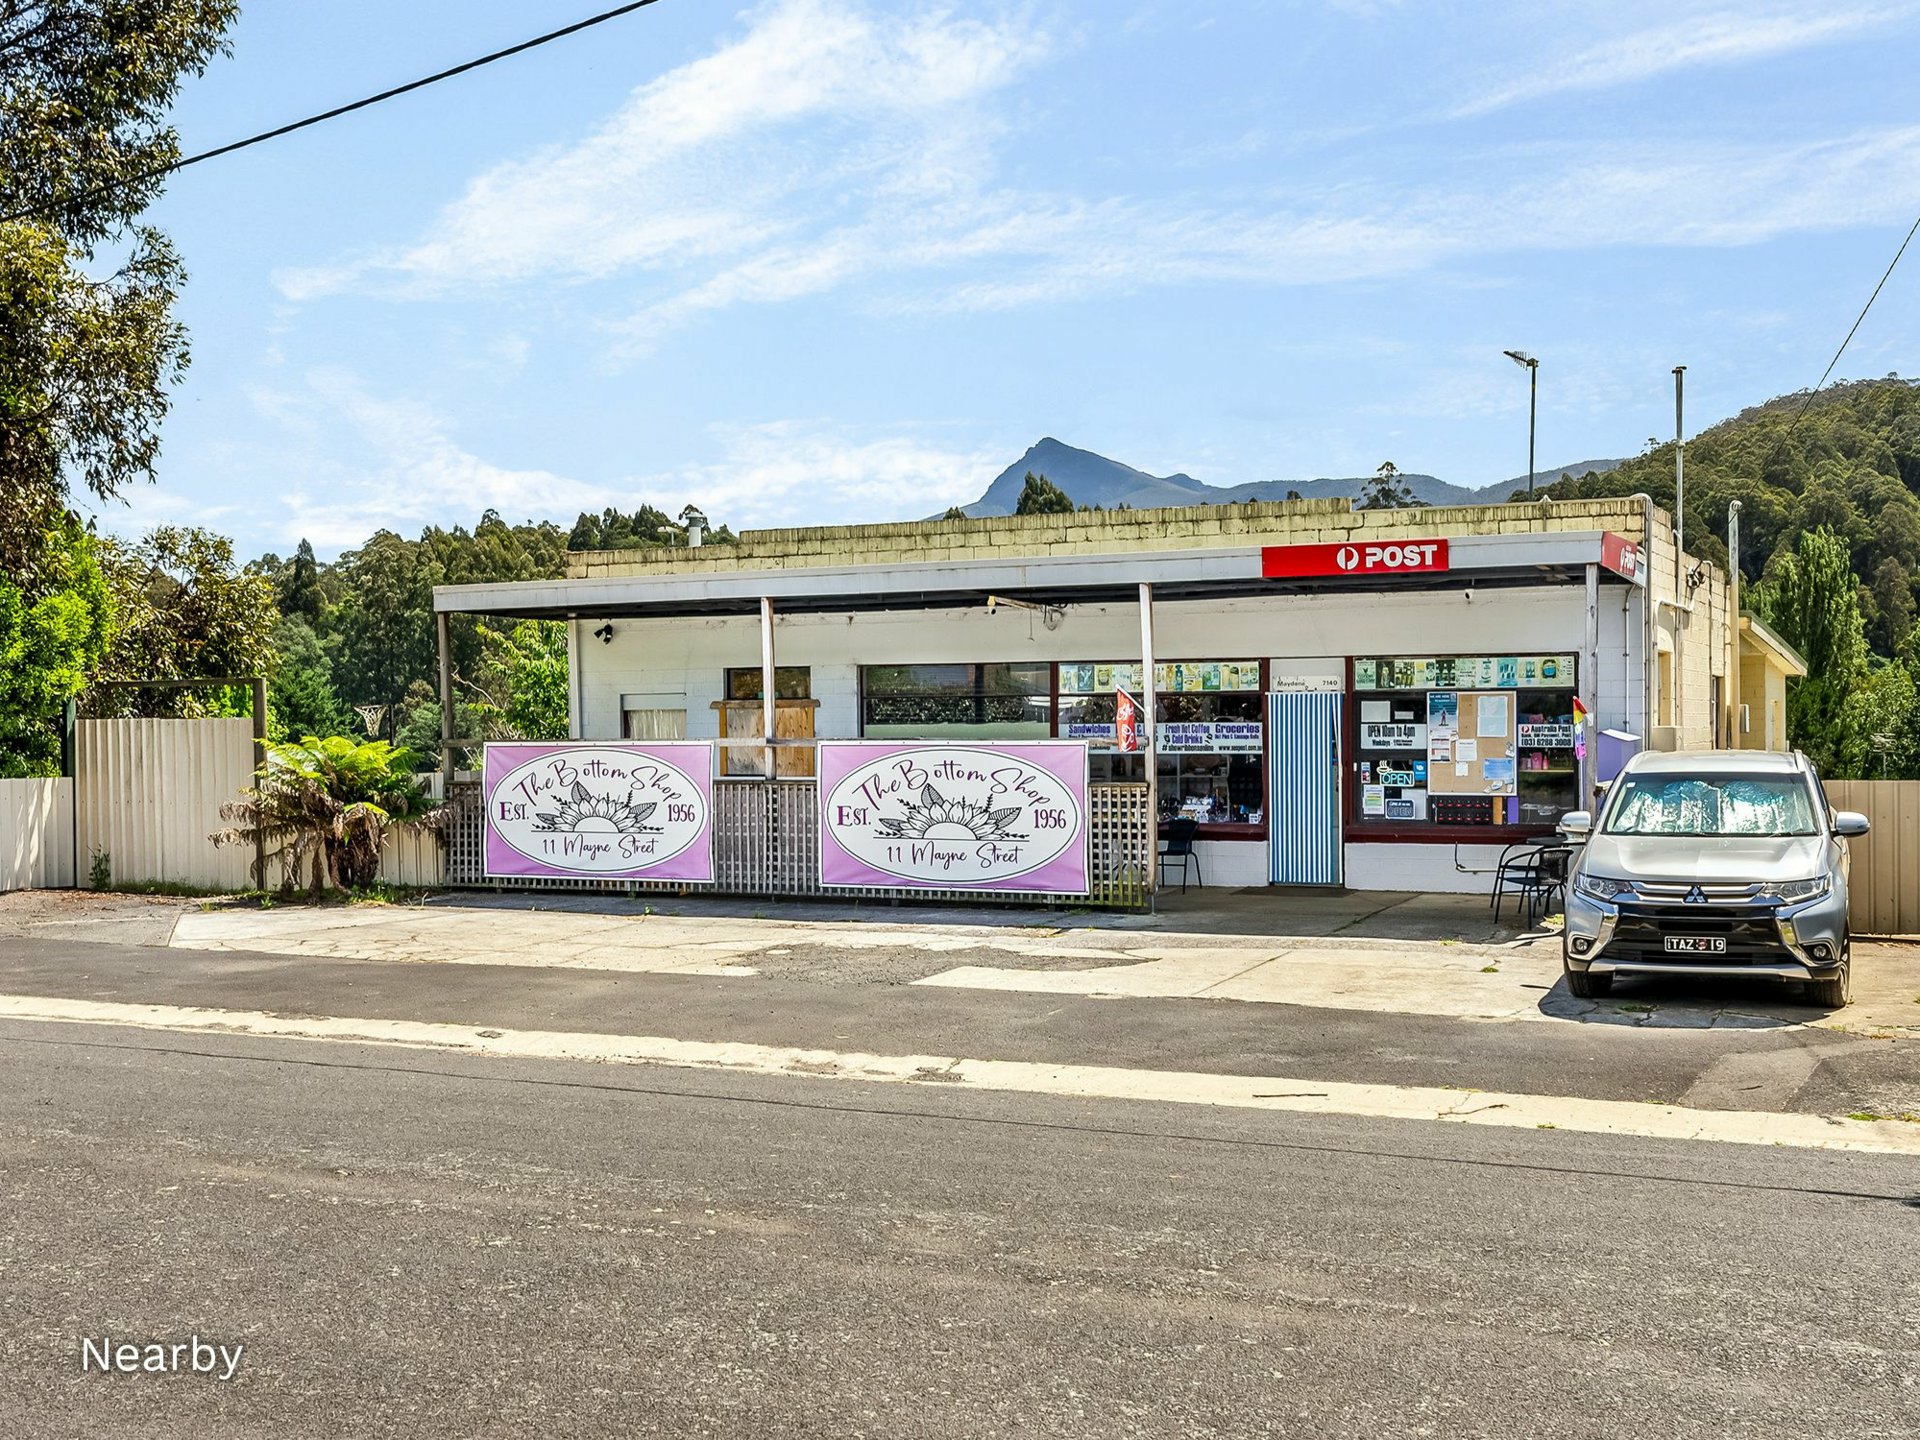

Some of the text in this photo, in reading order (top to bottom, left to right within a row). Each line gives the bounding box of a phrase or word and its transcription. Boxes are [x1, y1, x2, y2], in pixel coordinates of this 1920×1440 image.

[1365, 544, 1438, 568] POST
[1068, 724, 1111, 734] Sandwiches
[1215, 723, 1260, 733] Groceries
[1367, 724, 1381, 737] OPEN
[1403, 724, 1416, 739] 4pm
[1172, 734, 1203, 744] Cold Drinks
[512, 759, 682, 806] The Bottom Shop
[851, 759, 1051, 810] The Bottom Shop
[1382, 773, 1412, 785] OPEN
[667, 803, 696, 822] 1956
[1033, 808, 1067, 829] 1956
[542, 834, 659, 861] 11 Mayne Street
[886, 841, 1024, 870] 11 Mayne Street
